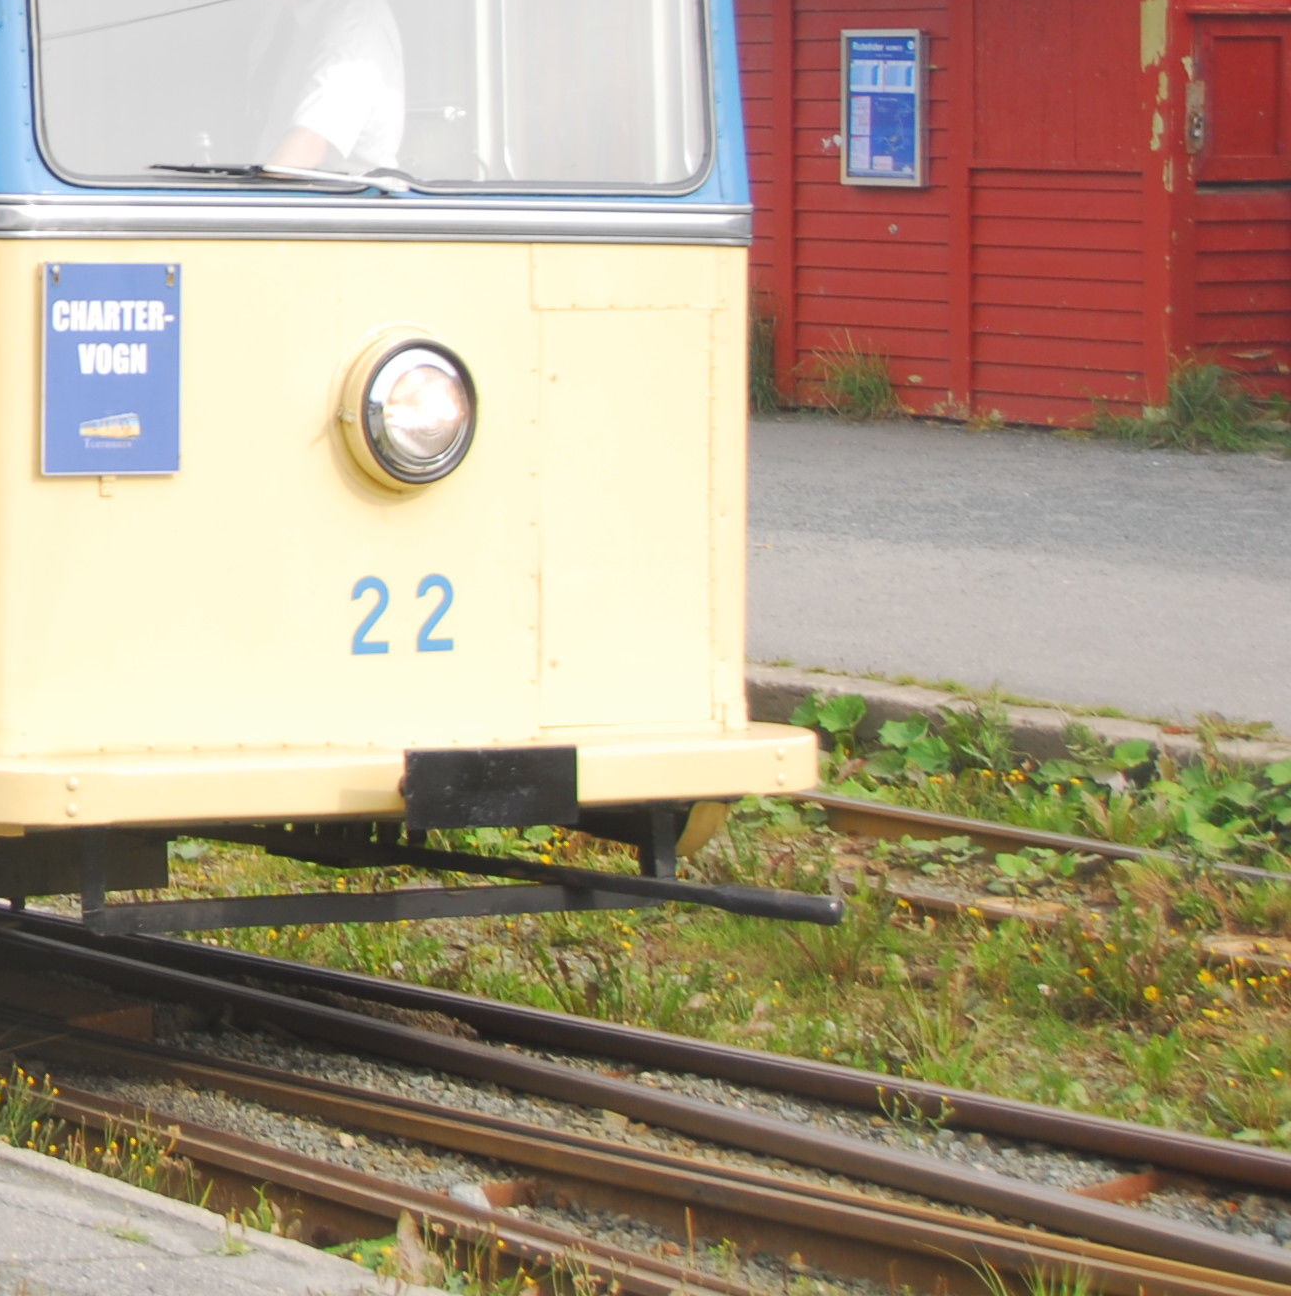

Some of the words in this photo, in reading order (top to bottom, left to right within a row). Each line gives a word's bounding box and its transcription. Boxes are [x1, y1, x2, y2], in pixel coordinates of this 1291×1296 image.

[52, 299, 175, 332] CHARTER-
[78, 343, 147, 375] VOGN
[350, 573, 455, 656] 22
